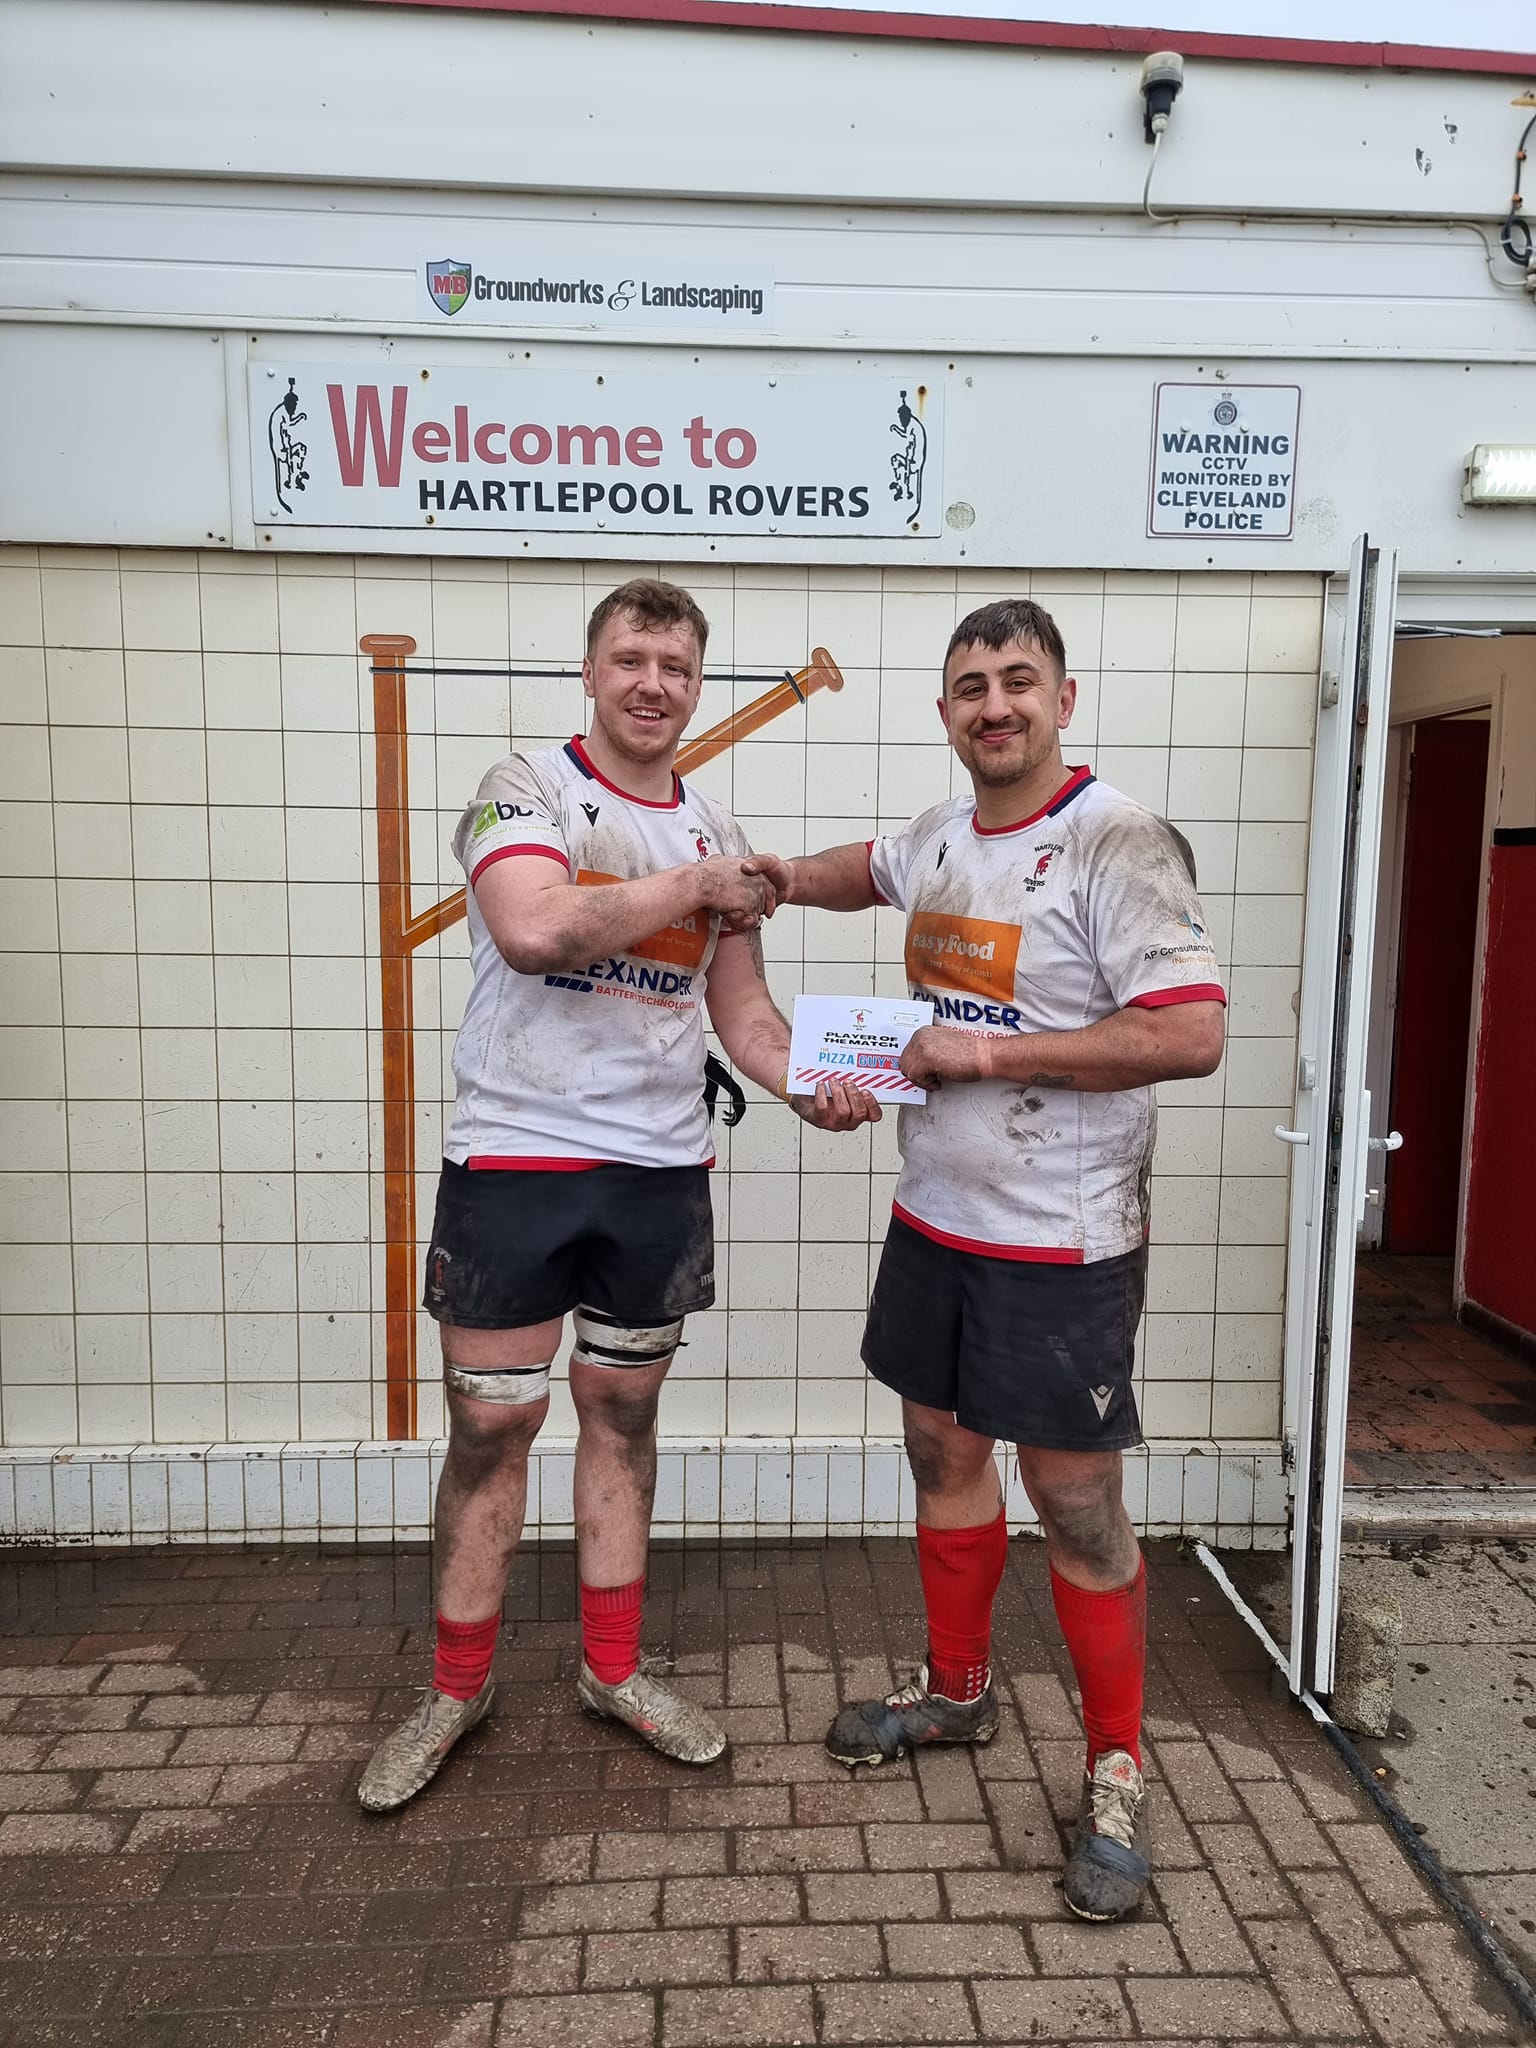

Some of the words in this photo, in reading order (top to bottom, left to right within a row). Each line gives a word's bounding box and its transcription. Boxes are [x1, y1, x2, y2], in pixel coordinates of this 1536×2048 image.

[433, 274, 468, 295] MB
[474, 275, 604, 305] Groundworks
[607, 279, 637, 311] &
[641, 281, 763, 315] Landscaping
[325, 383, 663, 488] Welcome
[682, 416, 757, 470] to
[1162, 433, 1289, 455] WARNING
[1202, 457, 1247, 470] CCTV
[1161, 472, 1262, 486] MONITORED
[1268, 474, 1291, 487] BY
[418, 479, 692, 516] HARTLEPOOL
[709, 485, 870, 519] ROVERS
[1157, 490, 1286, 509] CLEVELAND
[1184, 513, 1263, 530] POLICE
[1143, 950, 1158, 961] AP
[567, 958, 693, 996] EXANDER
[823, 1037, 847, 1045] THE
[848, 1040, 899, 1049] MATCH
[826, 1032, 877, 1041] PLAYER
[818, 1052, 855, 1066] PIZZA
